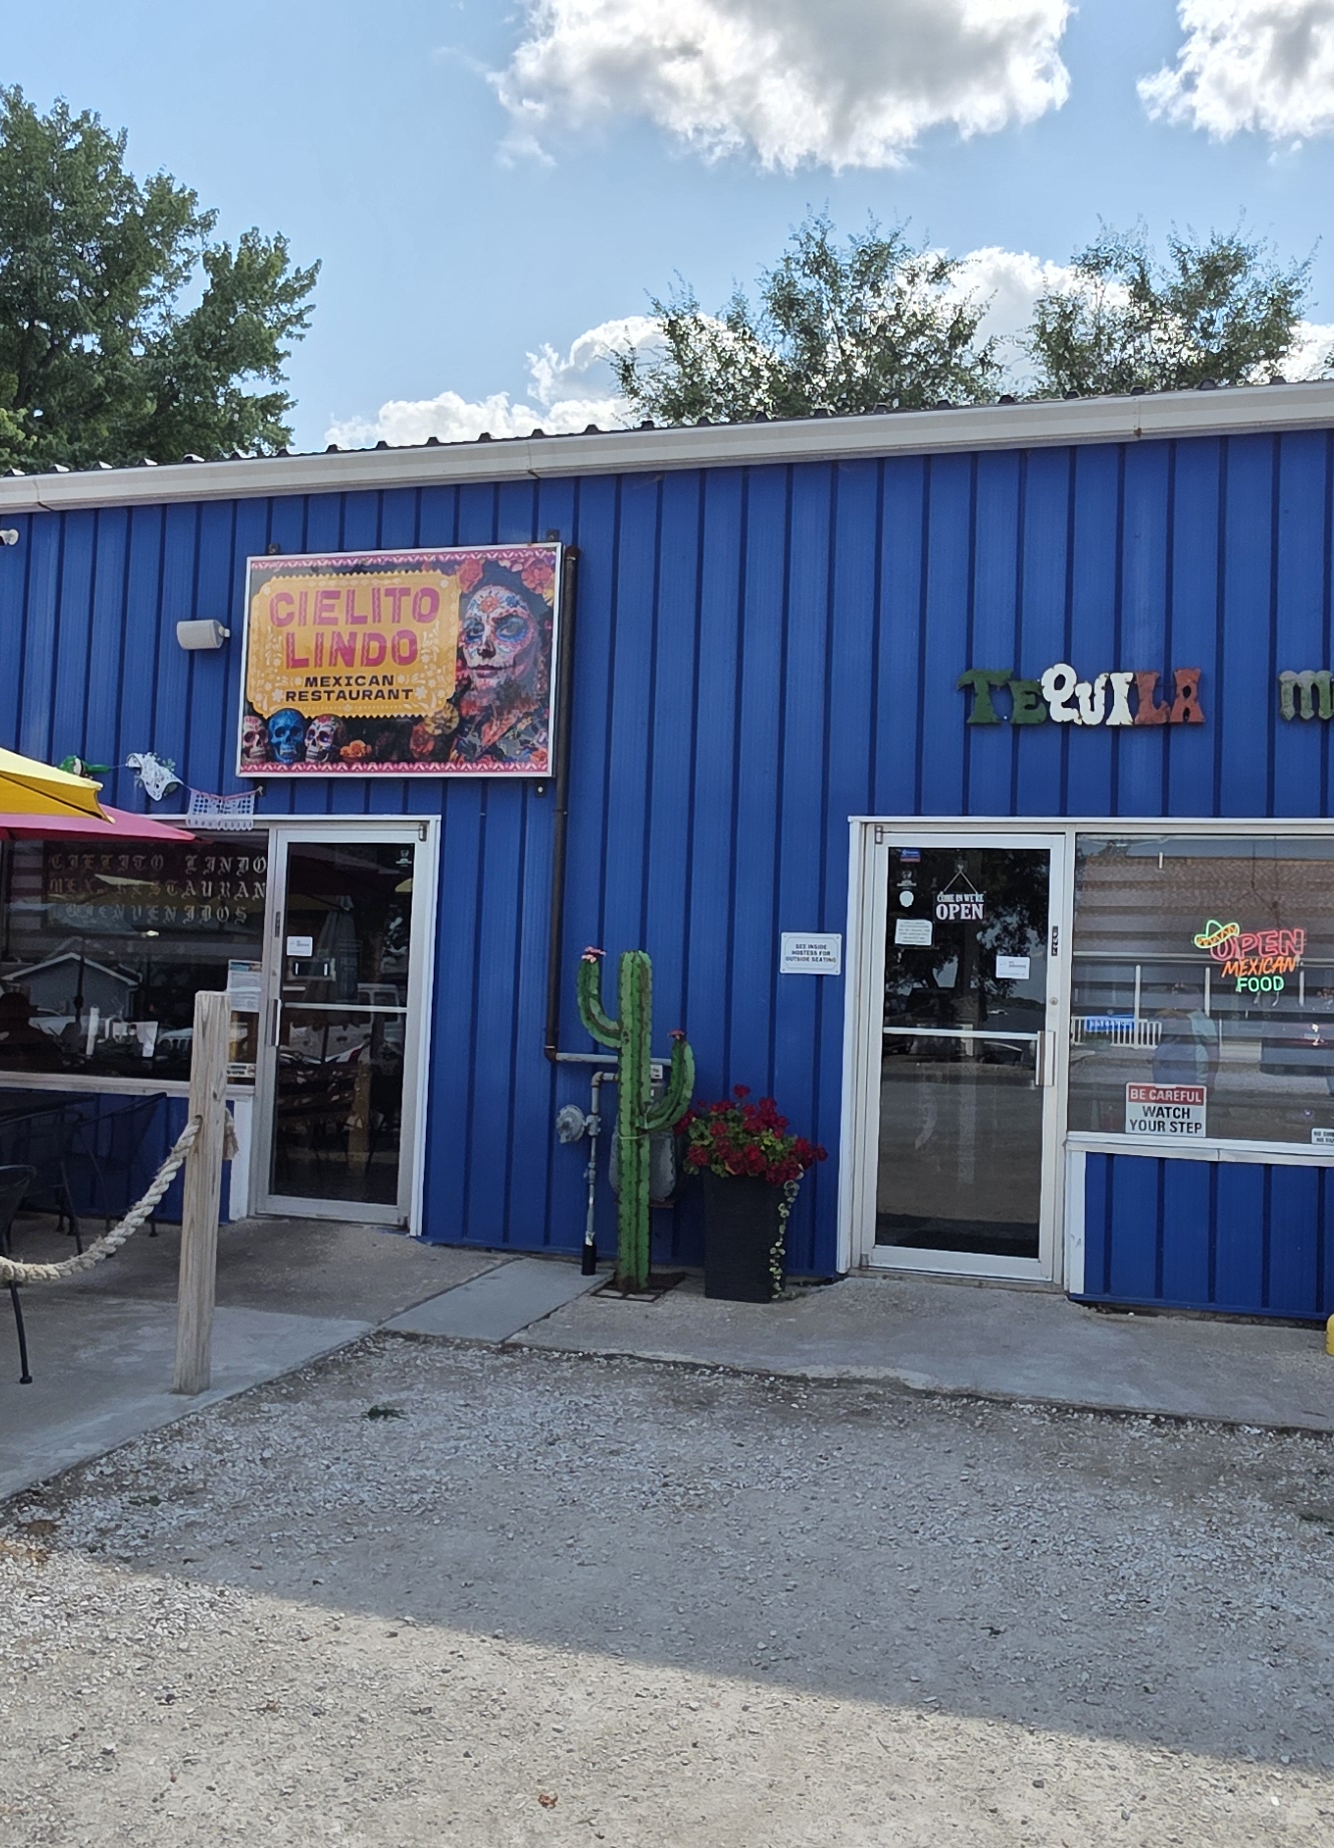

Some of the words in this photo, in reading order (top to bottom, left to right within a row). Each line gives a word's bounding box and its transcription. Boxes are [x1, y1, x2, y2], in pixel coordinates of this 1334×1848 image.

[269, 587, 440, 628] CIELITO
[285, 629, 418, 669] LINDO
[304, 675, 395, 688] MEXICAN
[285, 688, 414, 702] RESTAURANT
[957, 663, 1206, 725] TEQUILA
[51, 853, 164, 872] CIELITO
[184, 855, 266, 877] LINDO
[936, 903, 984, 920] OPEN
[1210, 928, 1305, 961] OPEN
[1221, 956, 1296, 978] MEXICAN
[1235, 975, 1284, 993] FOOD
[1130, 1088, 1146, 1100] BE
[1149, 1089, 1202, 1103] CAREFUL
[1142, 1105, 1191, 1119] WATCH
[1130, 1119, 1165, 1132] YOUR
[1169, 1121, 1202, 1134] STEP
